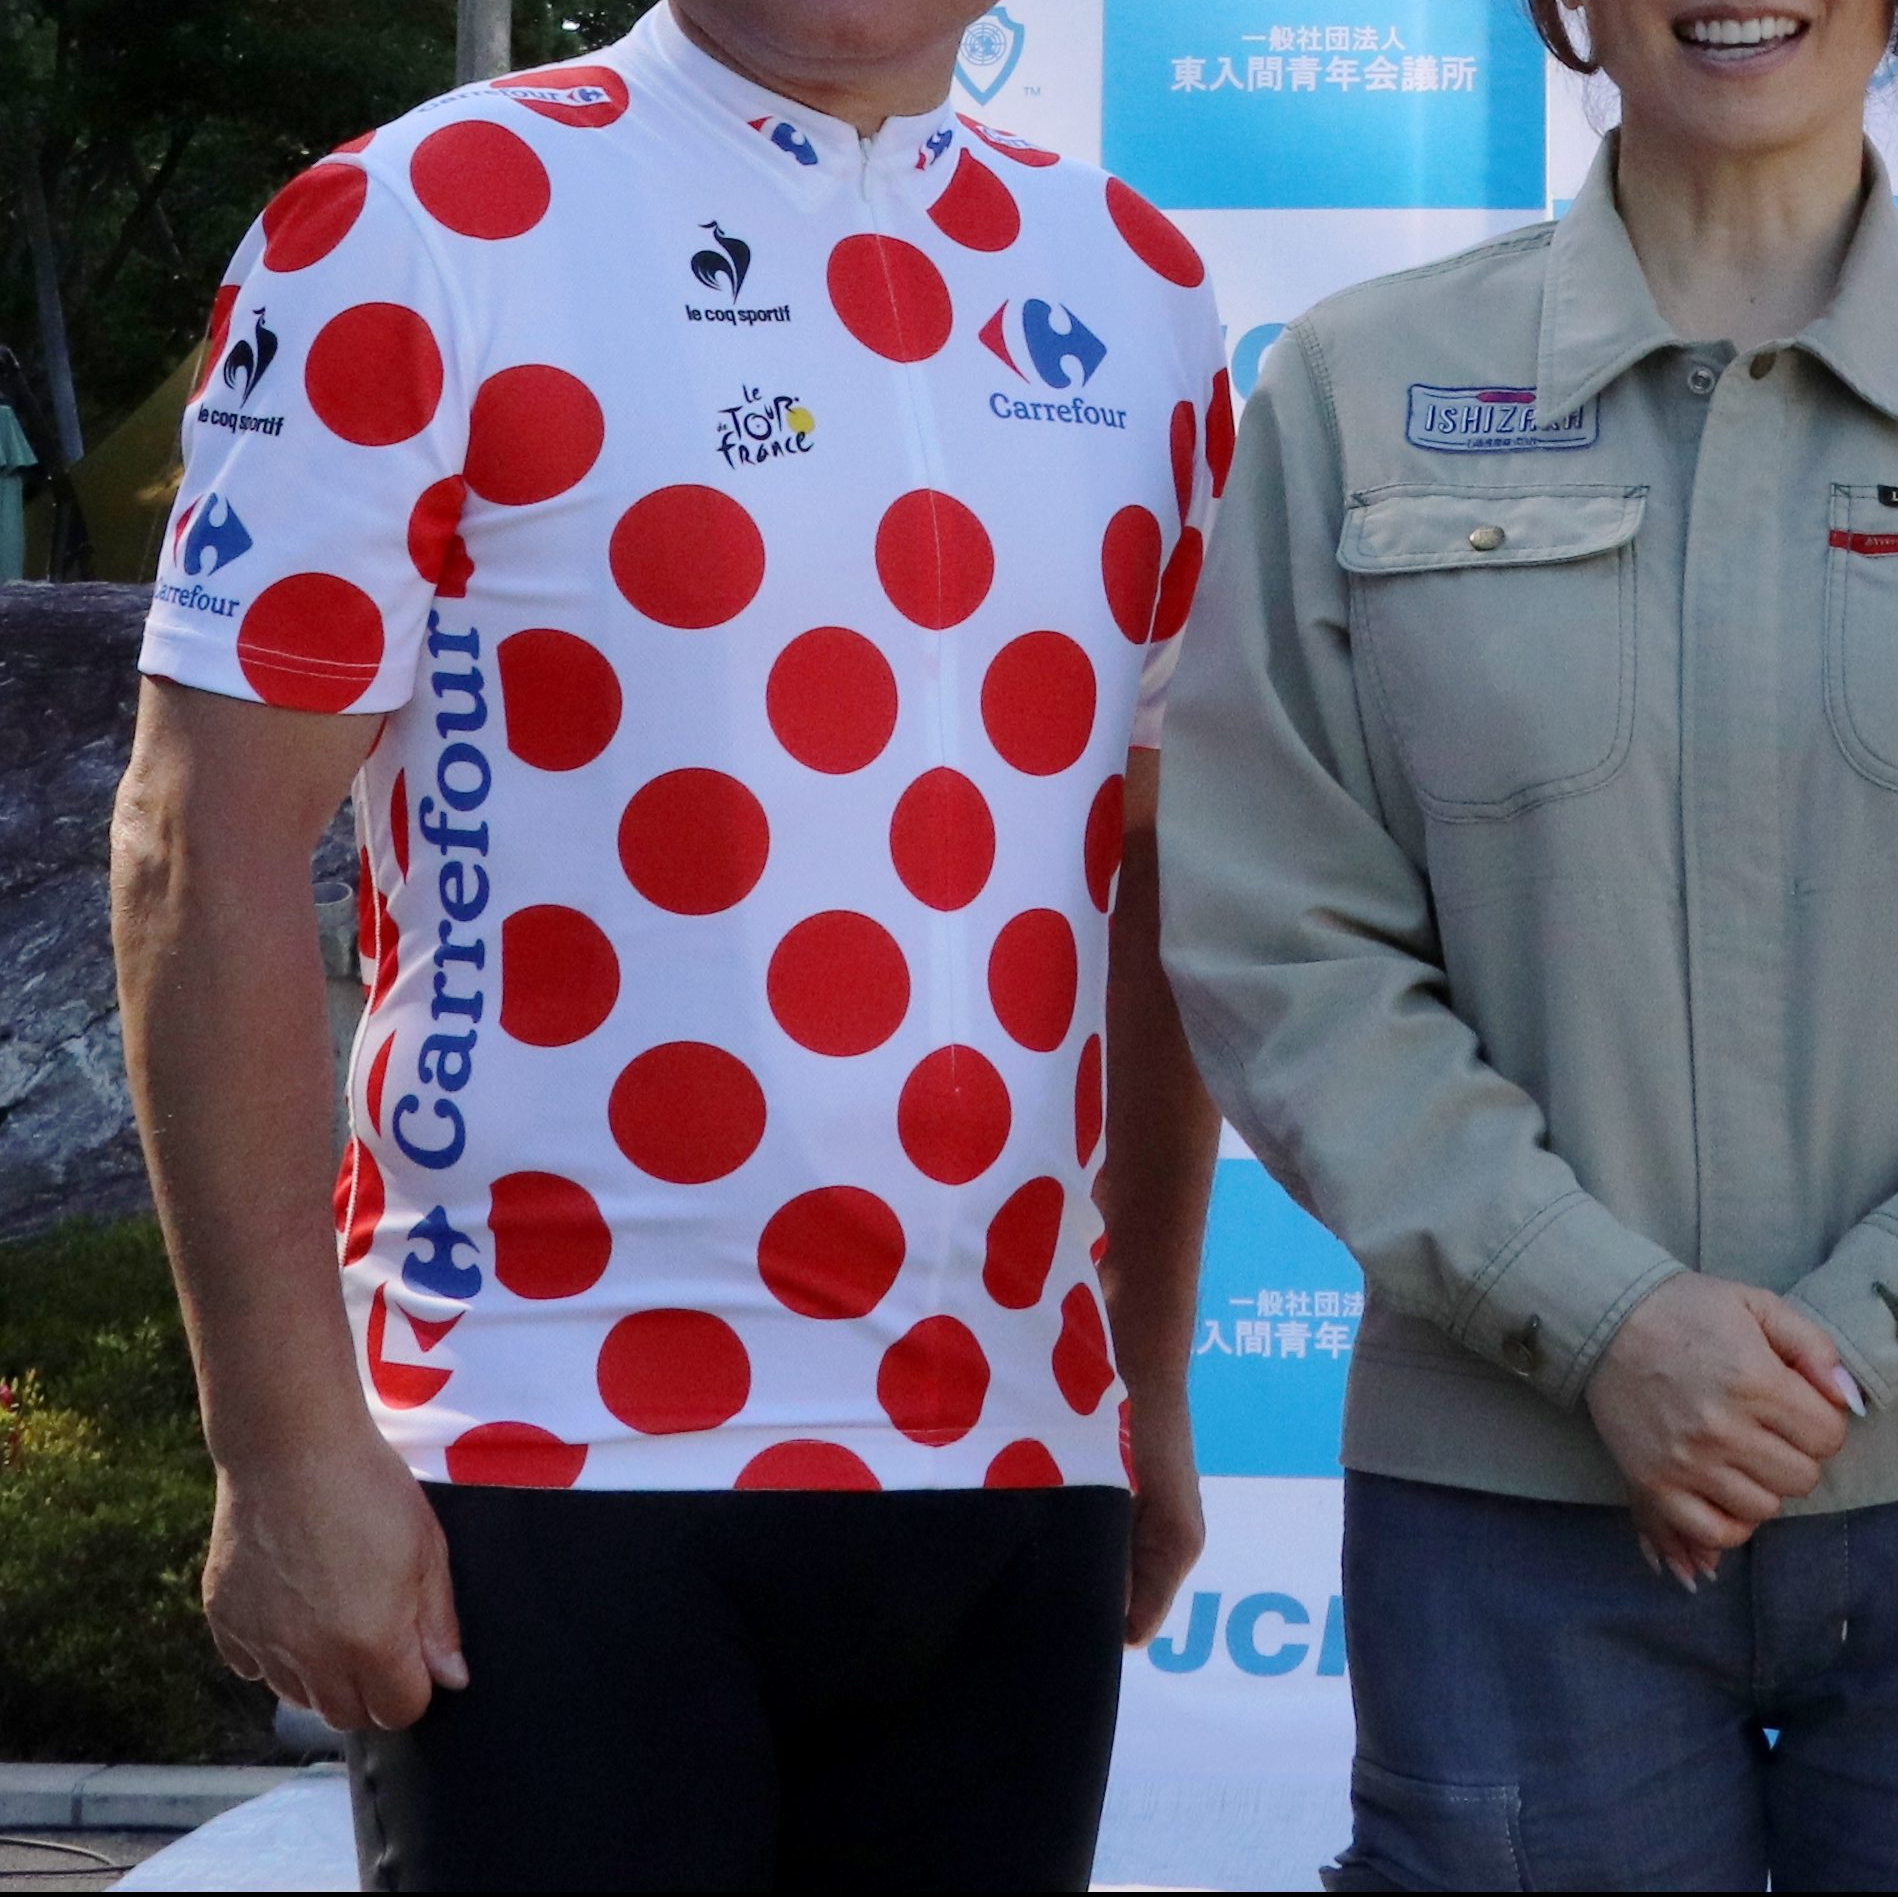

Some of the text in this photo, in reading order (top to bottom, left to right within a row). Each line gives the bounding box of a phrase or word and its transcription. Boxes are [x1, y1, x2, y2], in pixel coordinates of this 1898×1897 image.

[1241, 25, 1406, 53] 一般社団法人
[1170, 54, 1478, 93] 東入間青年会議所
[705, 309, 737, 326] coq
[738, 305, 791, 326] sportif
[211, 410, 238, 434] coq
[989, 392, 1127, 430] Carrefour
[155, 584, 240, 617] arrefour
[392, 610, 493, 1172] Carrefour
[1188, 1319, 1354, 1360] 入間青年
